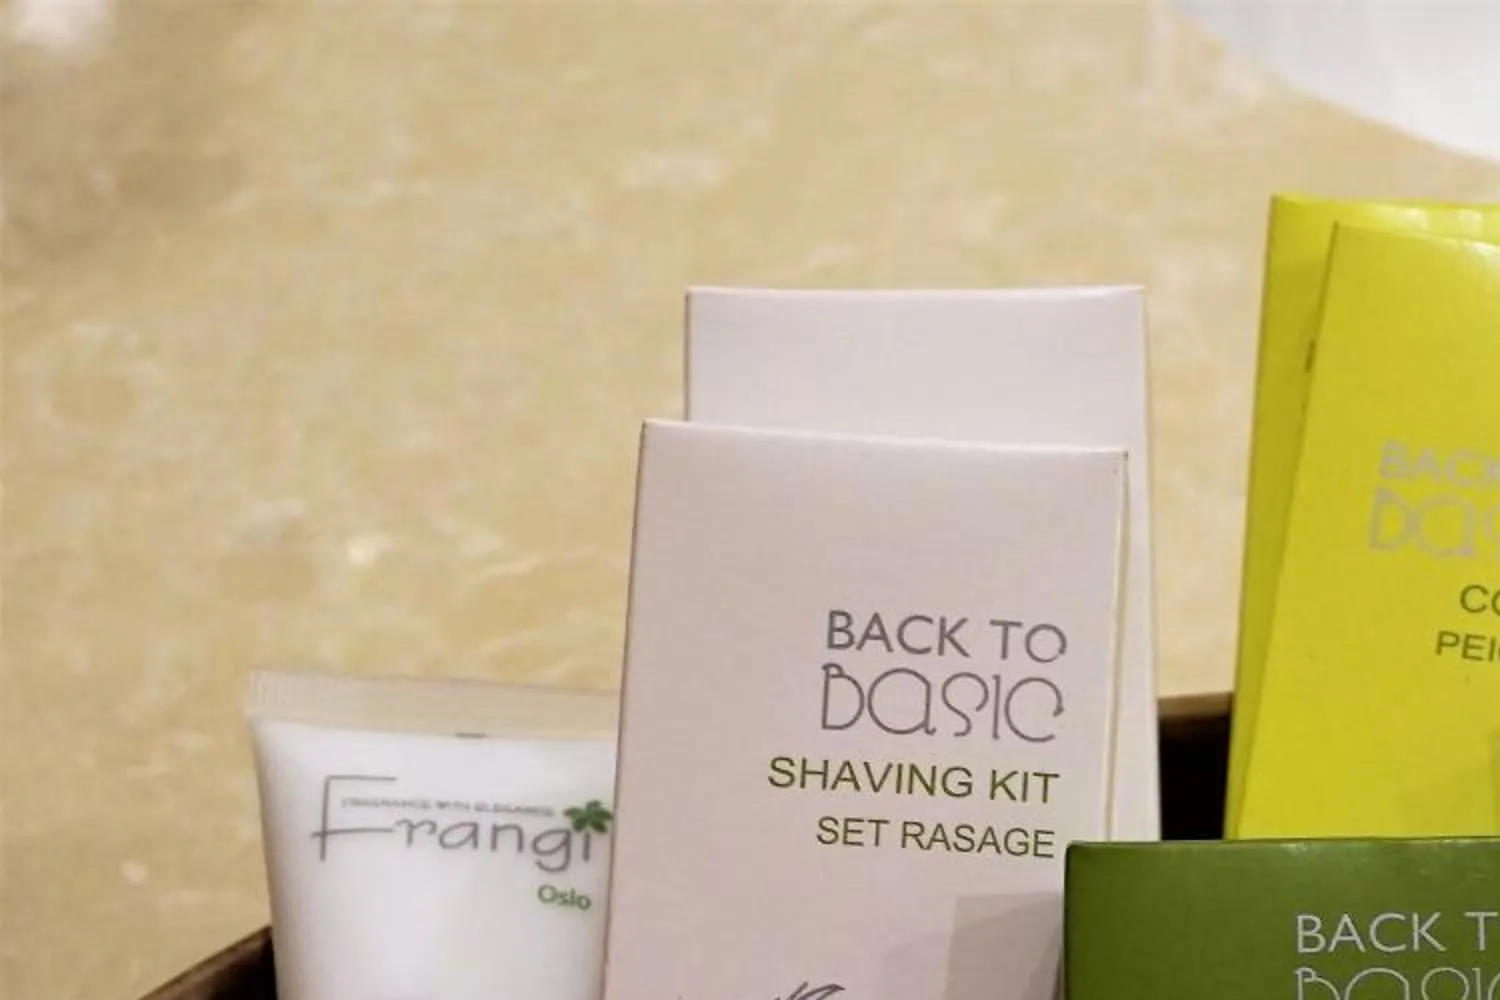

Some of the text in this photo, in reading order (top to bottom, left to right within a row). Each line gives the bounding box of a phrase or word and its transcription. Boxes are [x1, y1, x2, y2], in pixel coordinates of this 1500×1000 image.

[827, 610, 1067, 663] BACK TO
[767, 757, 1061, 804] SHAVING KIT
[310, 774, 592, 873] Frangi
[816, 816, 1056, 859] SET RASAGE
[537, 884, 592, 910] Oslo
[1296, 912, 1447, 954] BACK
